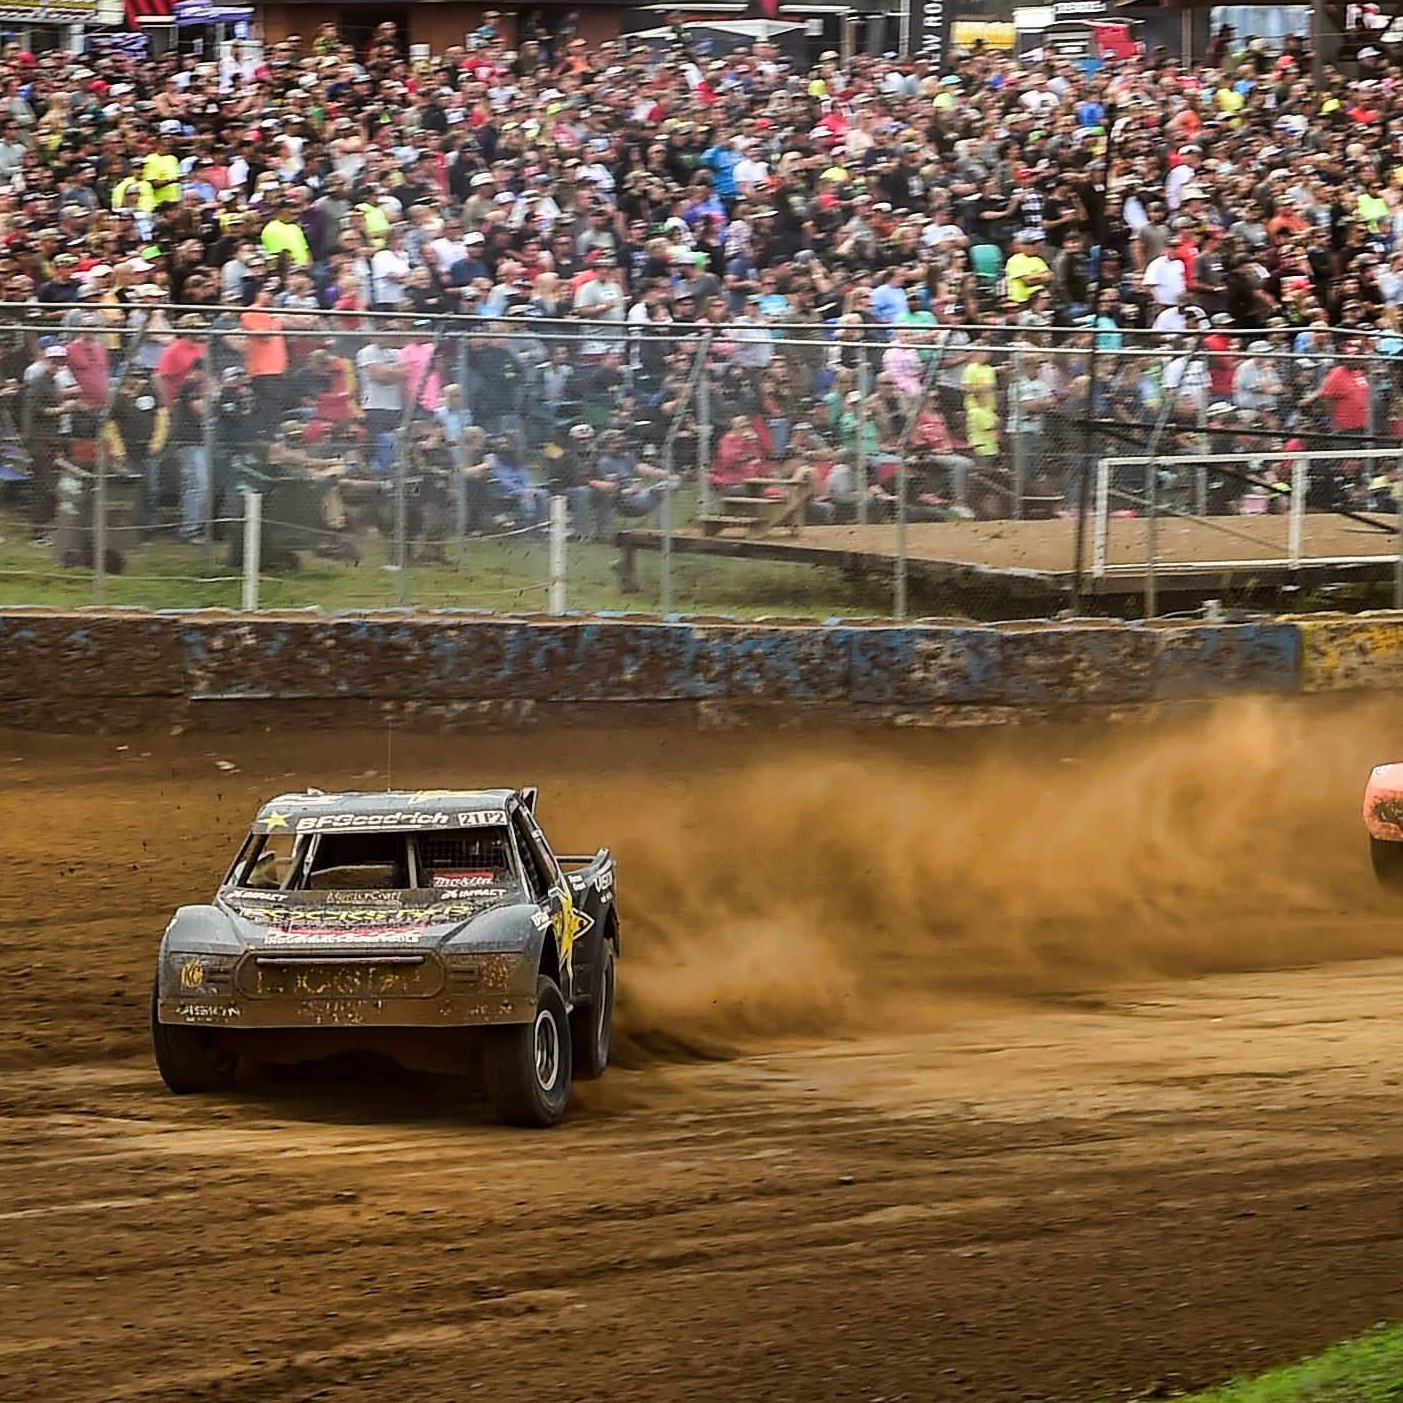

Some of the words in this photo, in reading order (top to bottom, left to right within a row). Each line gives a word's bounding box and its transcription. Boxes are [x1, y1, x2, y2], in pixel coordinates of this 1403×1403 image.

[296, 811, 449, 830] BFGoodrich
[460, 812, 479, 826] 21
[458, 888, 508, 899] IMPACT
